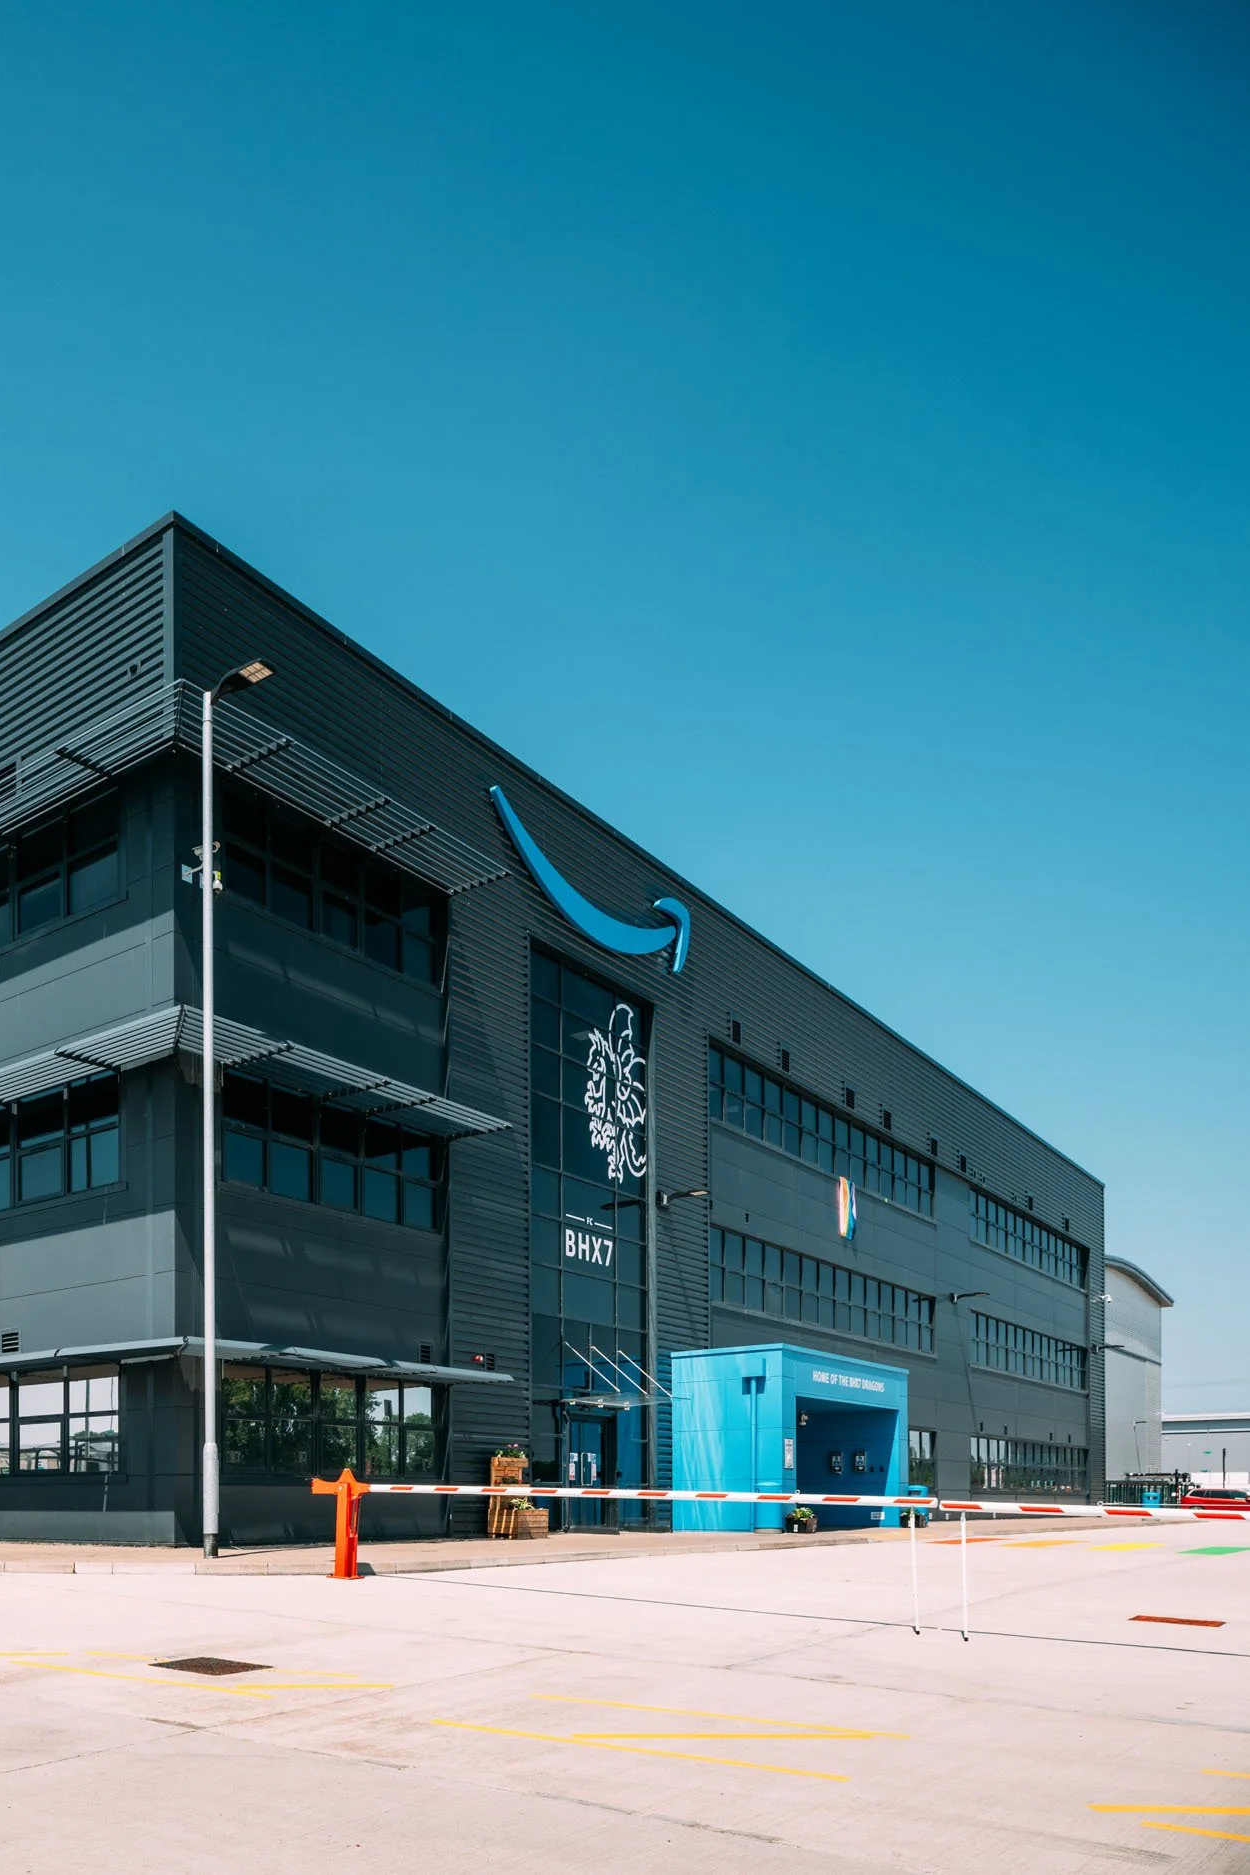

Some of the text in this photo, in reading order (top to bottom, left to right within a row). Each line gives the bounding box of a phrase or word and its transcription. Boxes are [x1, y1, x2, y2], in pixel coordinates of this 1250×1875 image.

[586, 1217, 593, 1226] FC
[565, 1229, 613, 1267] BHX7
[812, 1370, 829, 1384] HOME
[830, 1374, 838, 1385] OF
[839, 1375, 849, 1387] THE
[862, 1379, 885, 1393] DRAGONS
